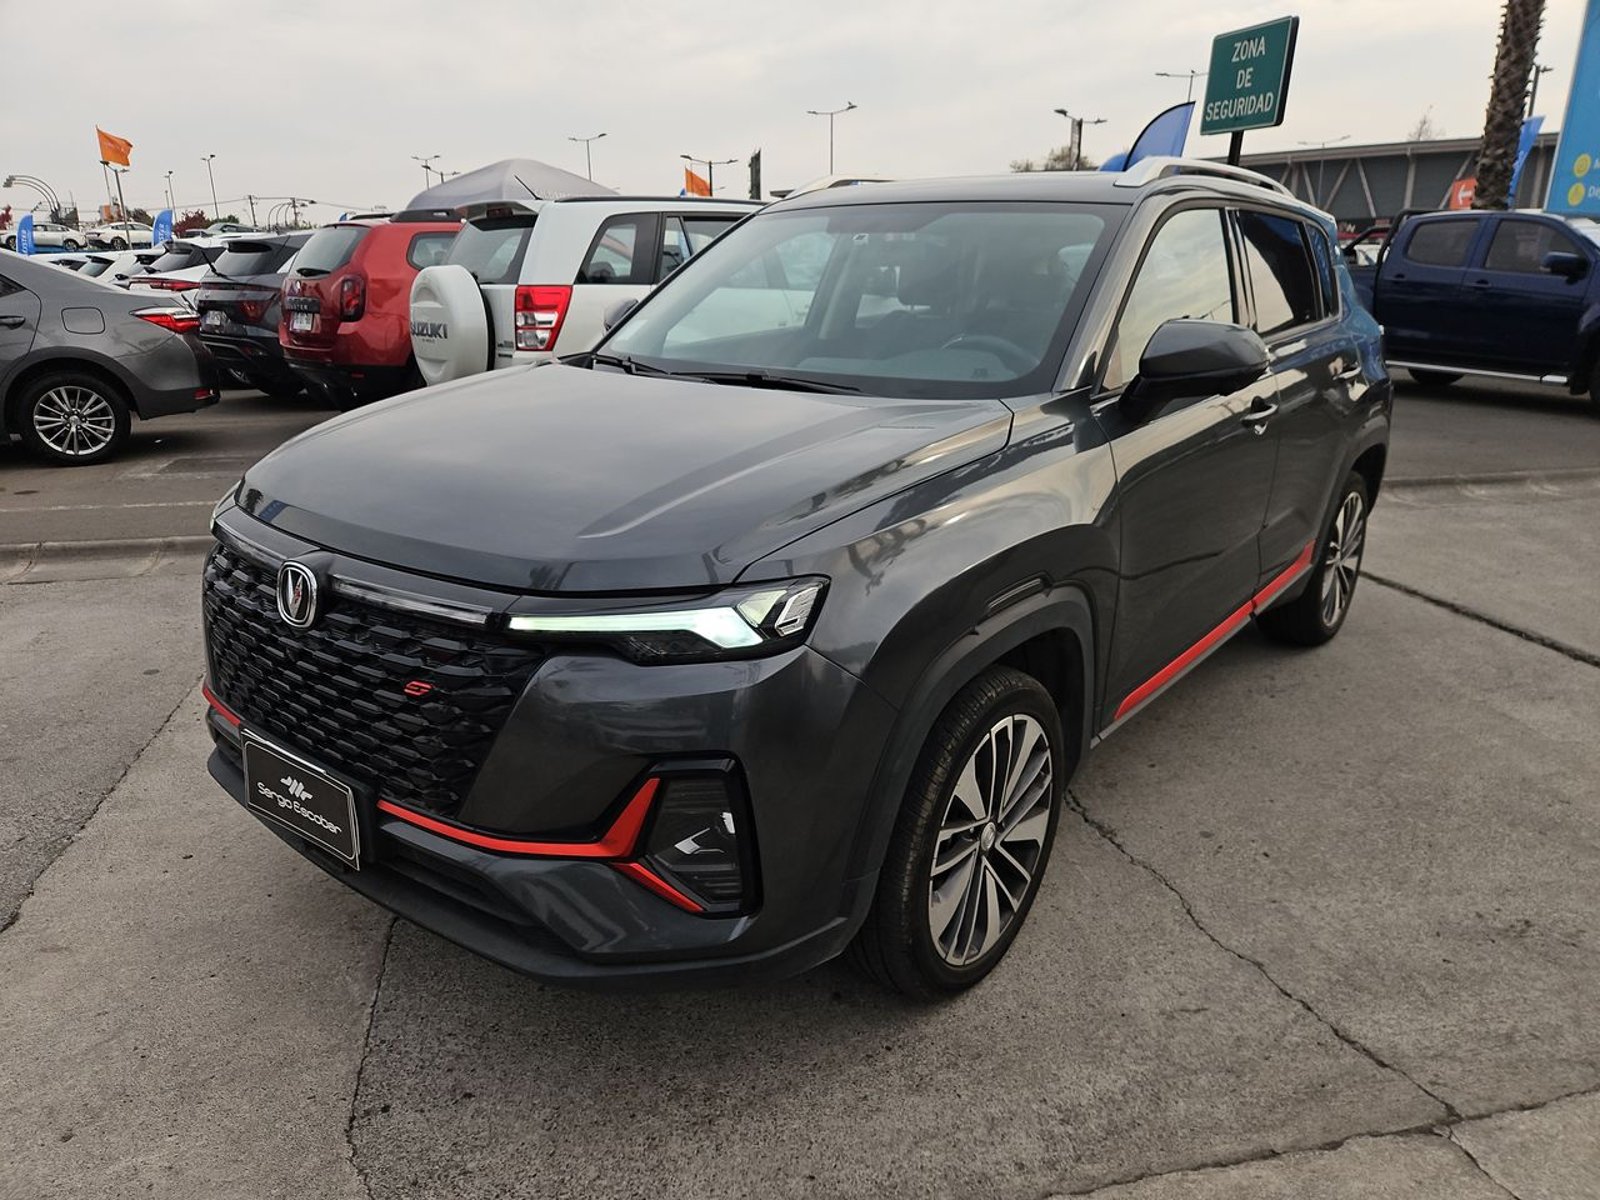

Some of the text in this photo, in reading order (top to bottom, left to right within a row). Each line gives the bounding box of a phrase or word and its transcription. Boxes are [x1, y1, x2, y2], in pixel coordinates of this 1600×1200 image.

[1231, 36, 1266, 62] ZONA
[1236, 67, 1254, 89] DE
[1205, 92, 1274, 121] SEGURIDAD
[411, 321, 448, 339] SUZUKI
